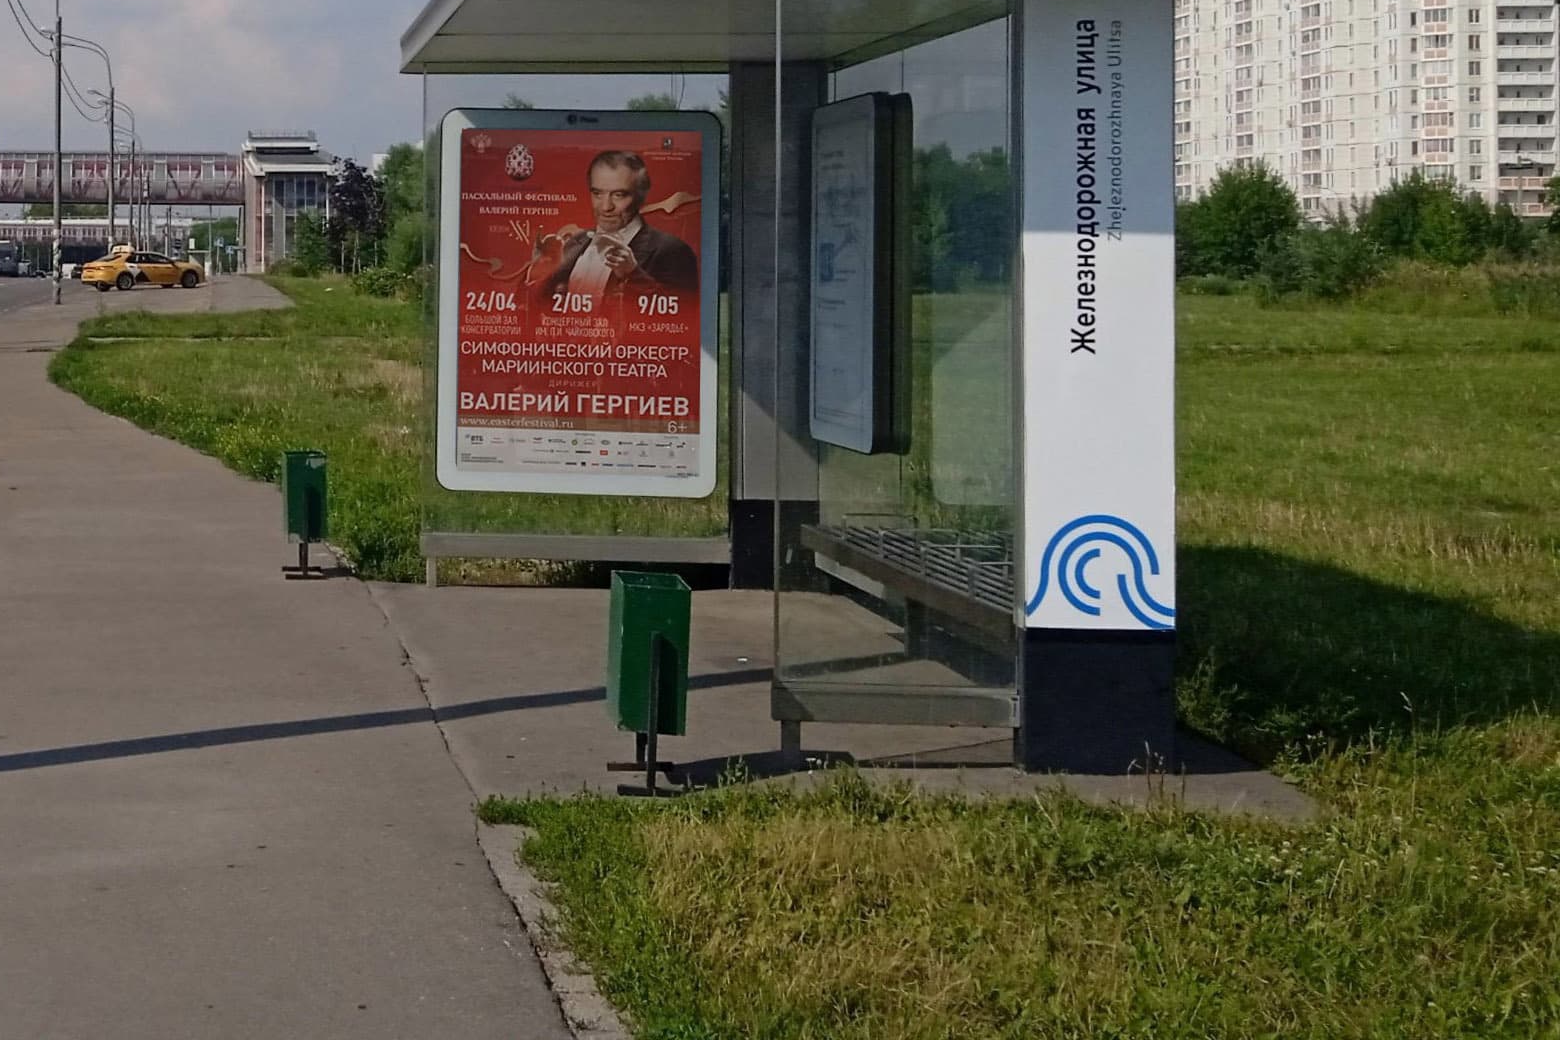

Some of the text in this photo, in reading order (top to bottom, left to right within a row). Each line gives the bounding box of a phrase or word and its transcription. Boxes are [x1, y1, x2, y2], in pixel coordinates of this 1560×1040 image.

[1106, 20, 1125, 241] Zheleznodorozhnaya Ulitsa
[1071, 19, 1102, 355] Железнодорожная улица
[466, 291, 517, 312] 24/04
[552, 292, 593, 314] 2/05
[638, 294, 679, 316] 9/05
[461, 340, 689, 361] СИМФОНИЧЕСКИЙ ОРКЕСТР
[482, 359, 668, 378] МАРИИНСКОГО ТЕАТРА
[460, 390, 689, 417] ВАЛЕРИЙ ГЕРГИЕВ
[460, 416, 574, 429] www.easterfestival.ru
[667, 420, 688, 434] 6+
